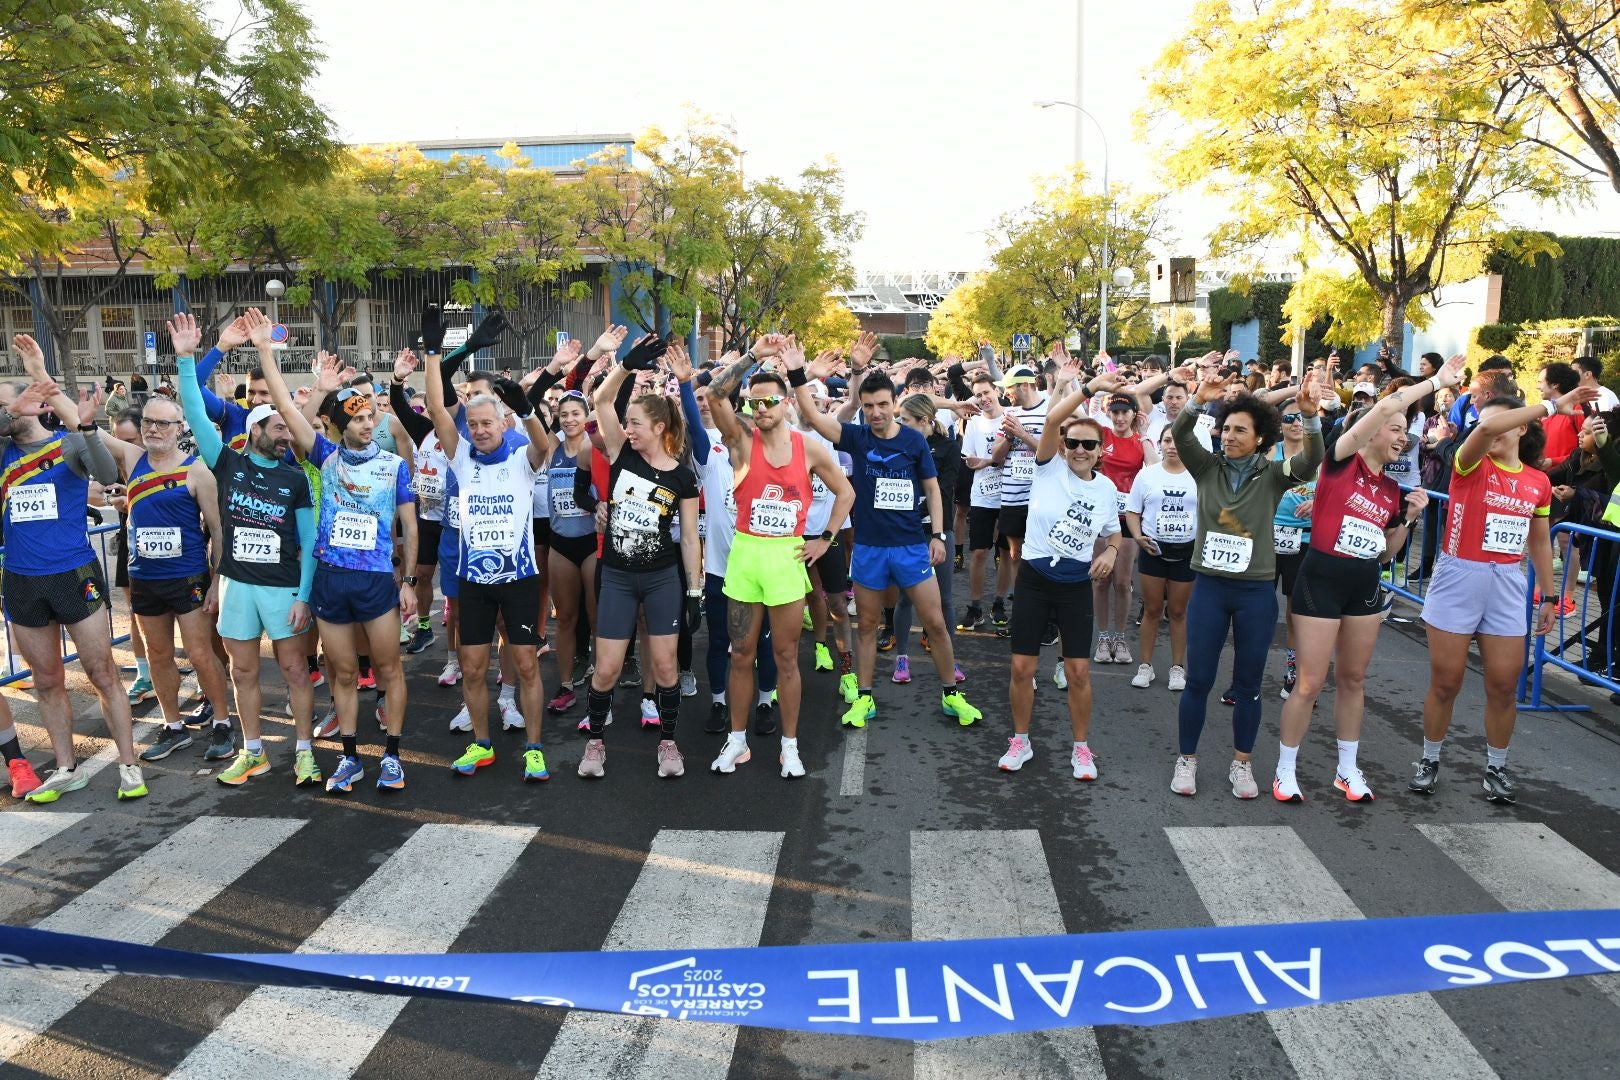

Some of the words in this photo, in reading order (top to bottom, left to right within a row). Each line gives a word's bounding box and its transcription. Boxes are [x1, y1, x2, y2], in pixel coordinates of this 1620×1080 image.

[1014, 466, 1033, 475] 1768
[11, 488, 48, 496] CASTILLOS
[420, 484, 436, 494] 1728
[812, 483, 824, 493] 46
[467, 494, 515, 505] ATLETISMO
[880, 491, 910, 503] 2059
[16, 500, 45, 513] 1961
[231, 490, 287, 518] MADRID
[468, 504, 513, 515] APOLANA
[557, 500, 577, 511] 185
[624, 498, 656, 513] CASTILLOS
[756, 503, 792, 512] CASTILLOS
[1117, 502, 1126, 511] 78
[338, 515, 373, 525] CASTILLOS
[622, 510, 650, 527] 1946
[757, 515, 787, 528] 1824
[1066, 508, 1092, 527] CAN
[1492, 518, 1527, 527] CASTILLOS
[1163, 523, 1187, 532] 1841
[1348, 521, 1382, 536] CASTILLOS
[239, 531, 275, 539] CASTILLOS
[338, 527, 367, 541] 1981
[477, 530, 505, 542] 1701
[1494, 531, 1523, 545] 1873
[143, 541, 173, 552] 1910
[1055, 530, 1084, 551] 2056
[1210, 536, 1247, 547] CASTILLOS
[1274, 538, 1294, 549] 562
[1347, 534, 1378, 553] 1872
[241, 543, 271, 555] 1773
[1211, 549, 1240, 564] 1712
[683, 969, 723, 981] 2025
[637, 982, 766, 998] CASTILLOS
[807, 947, 1321, 1024] ALICANTE
[670, 999, 764, 1010] CARRERA
